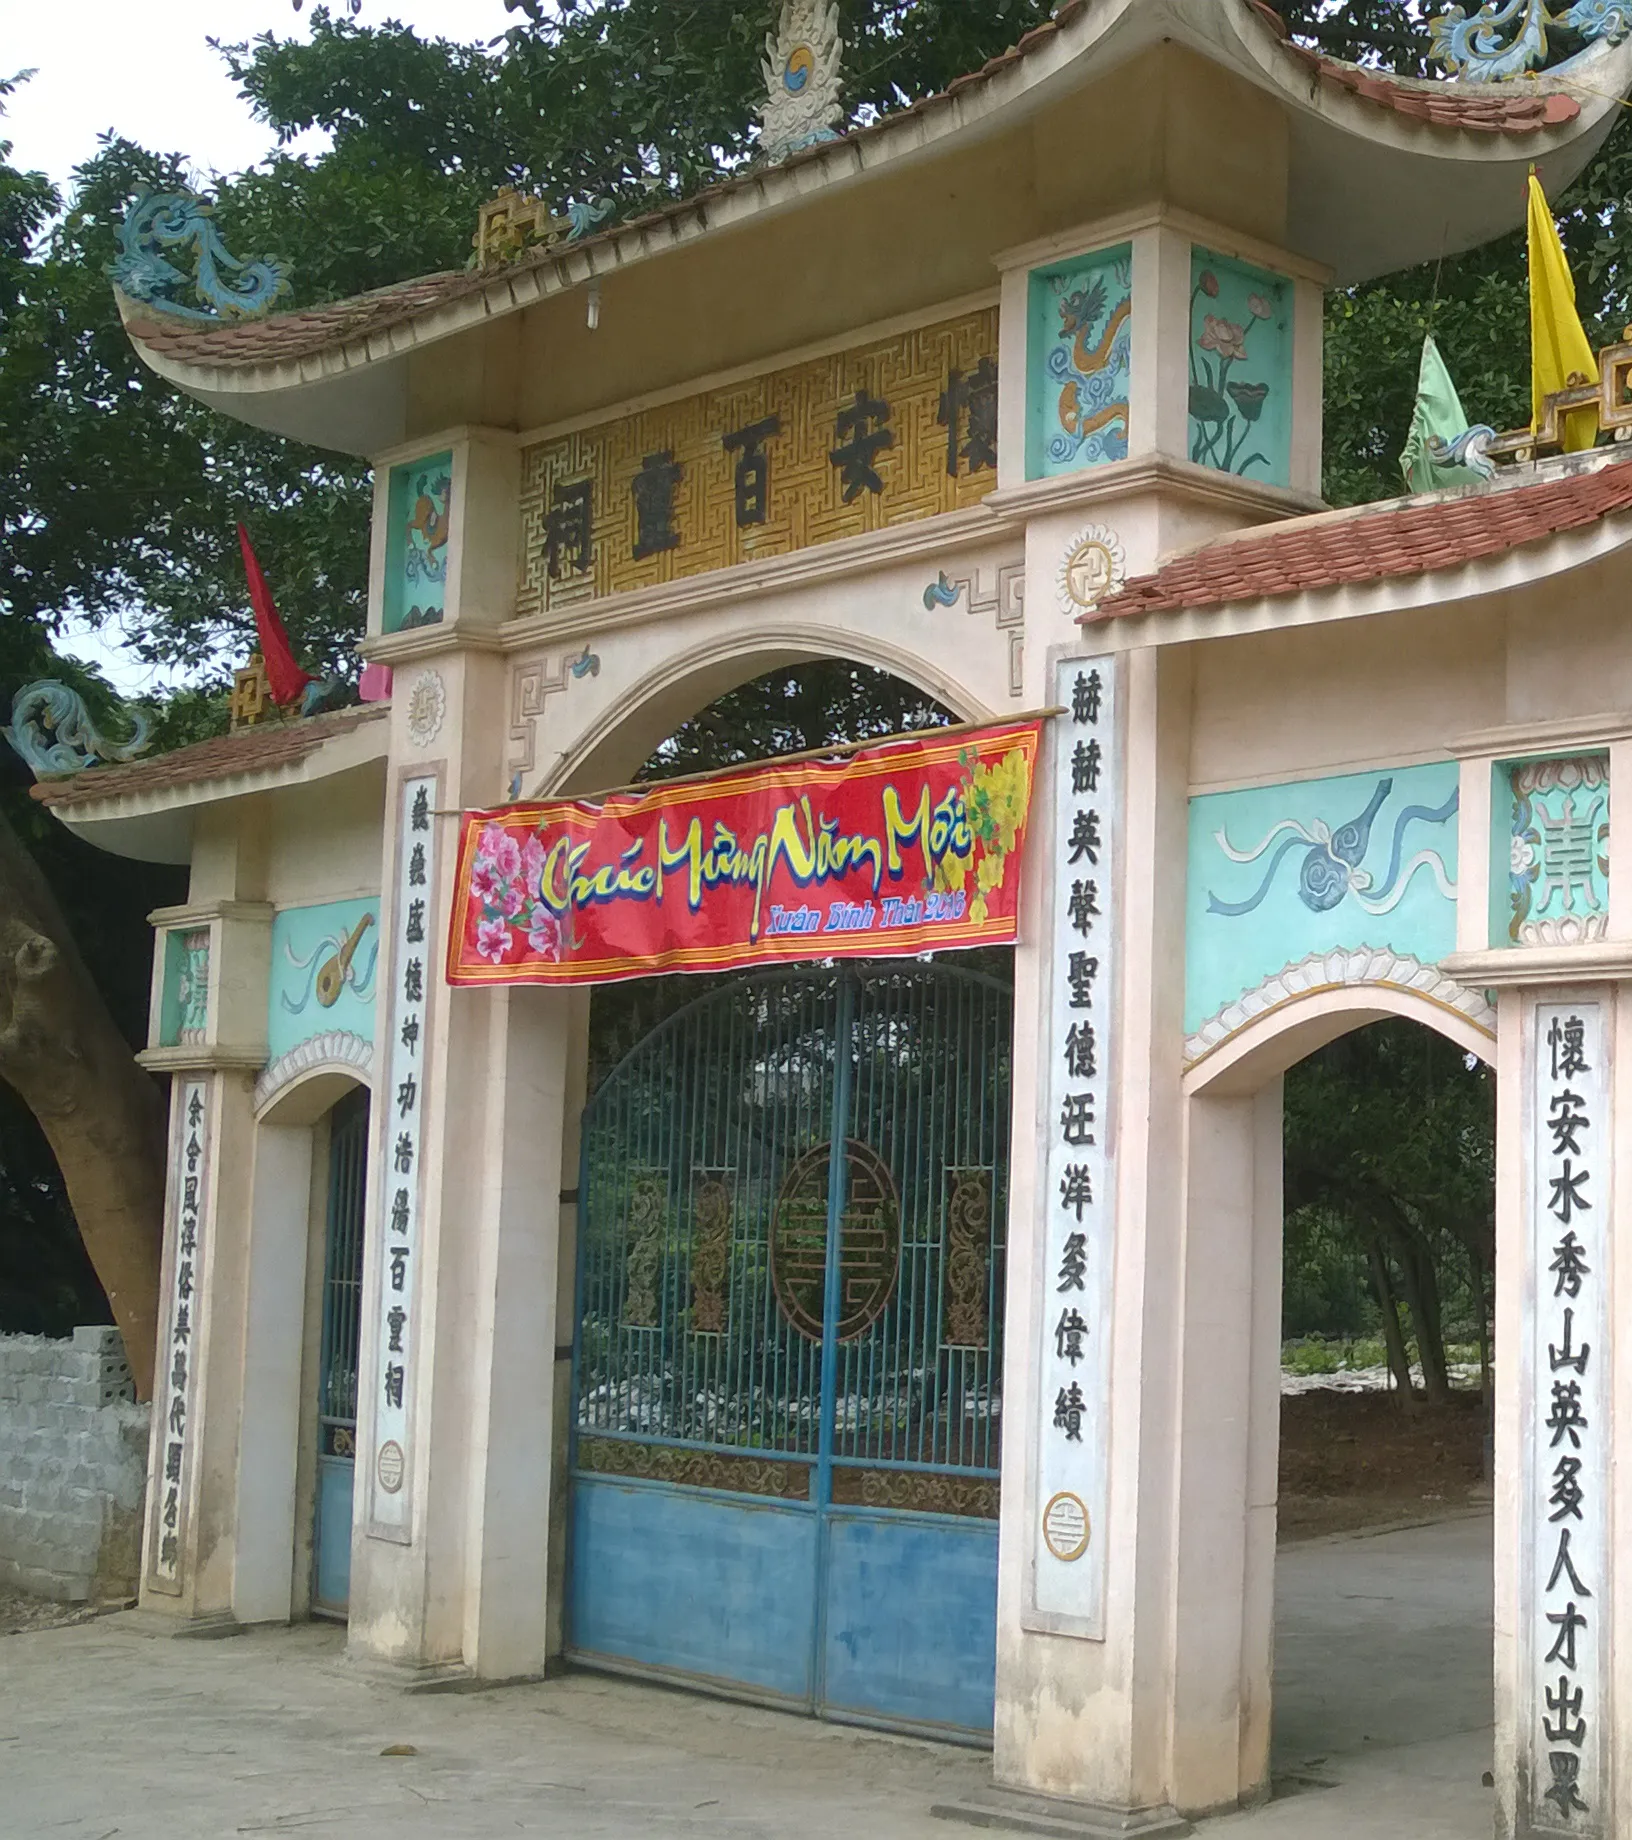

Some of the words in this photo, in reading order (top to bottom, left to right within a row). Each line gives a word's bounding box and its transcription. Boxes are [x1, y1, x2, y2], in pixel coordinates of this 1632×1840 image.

[540, 835, 656, 915] Chúc
[655, 816, 769, 944] Mừng
[765, 794, 882, 897] Năm
[882, 783, 973, 889] Mới
[765, 903, 821, 935] Xuân
[823, 900, 875, 932] Bính
[922, 889, 967, 922] 2016
